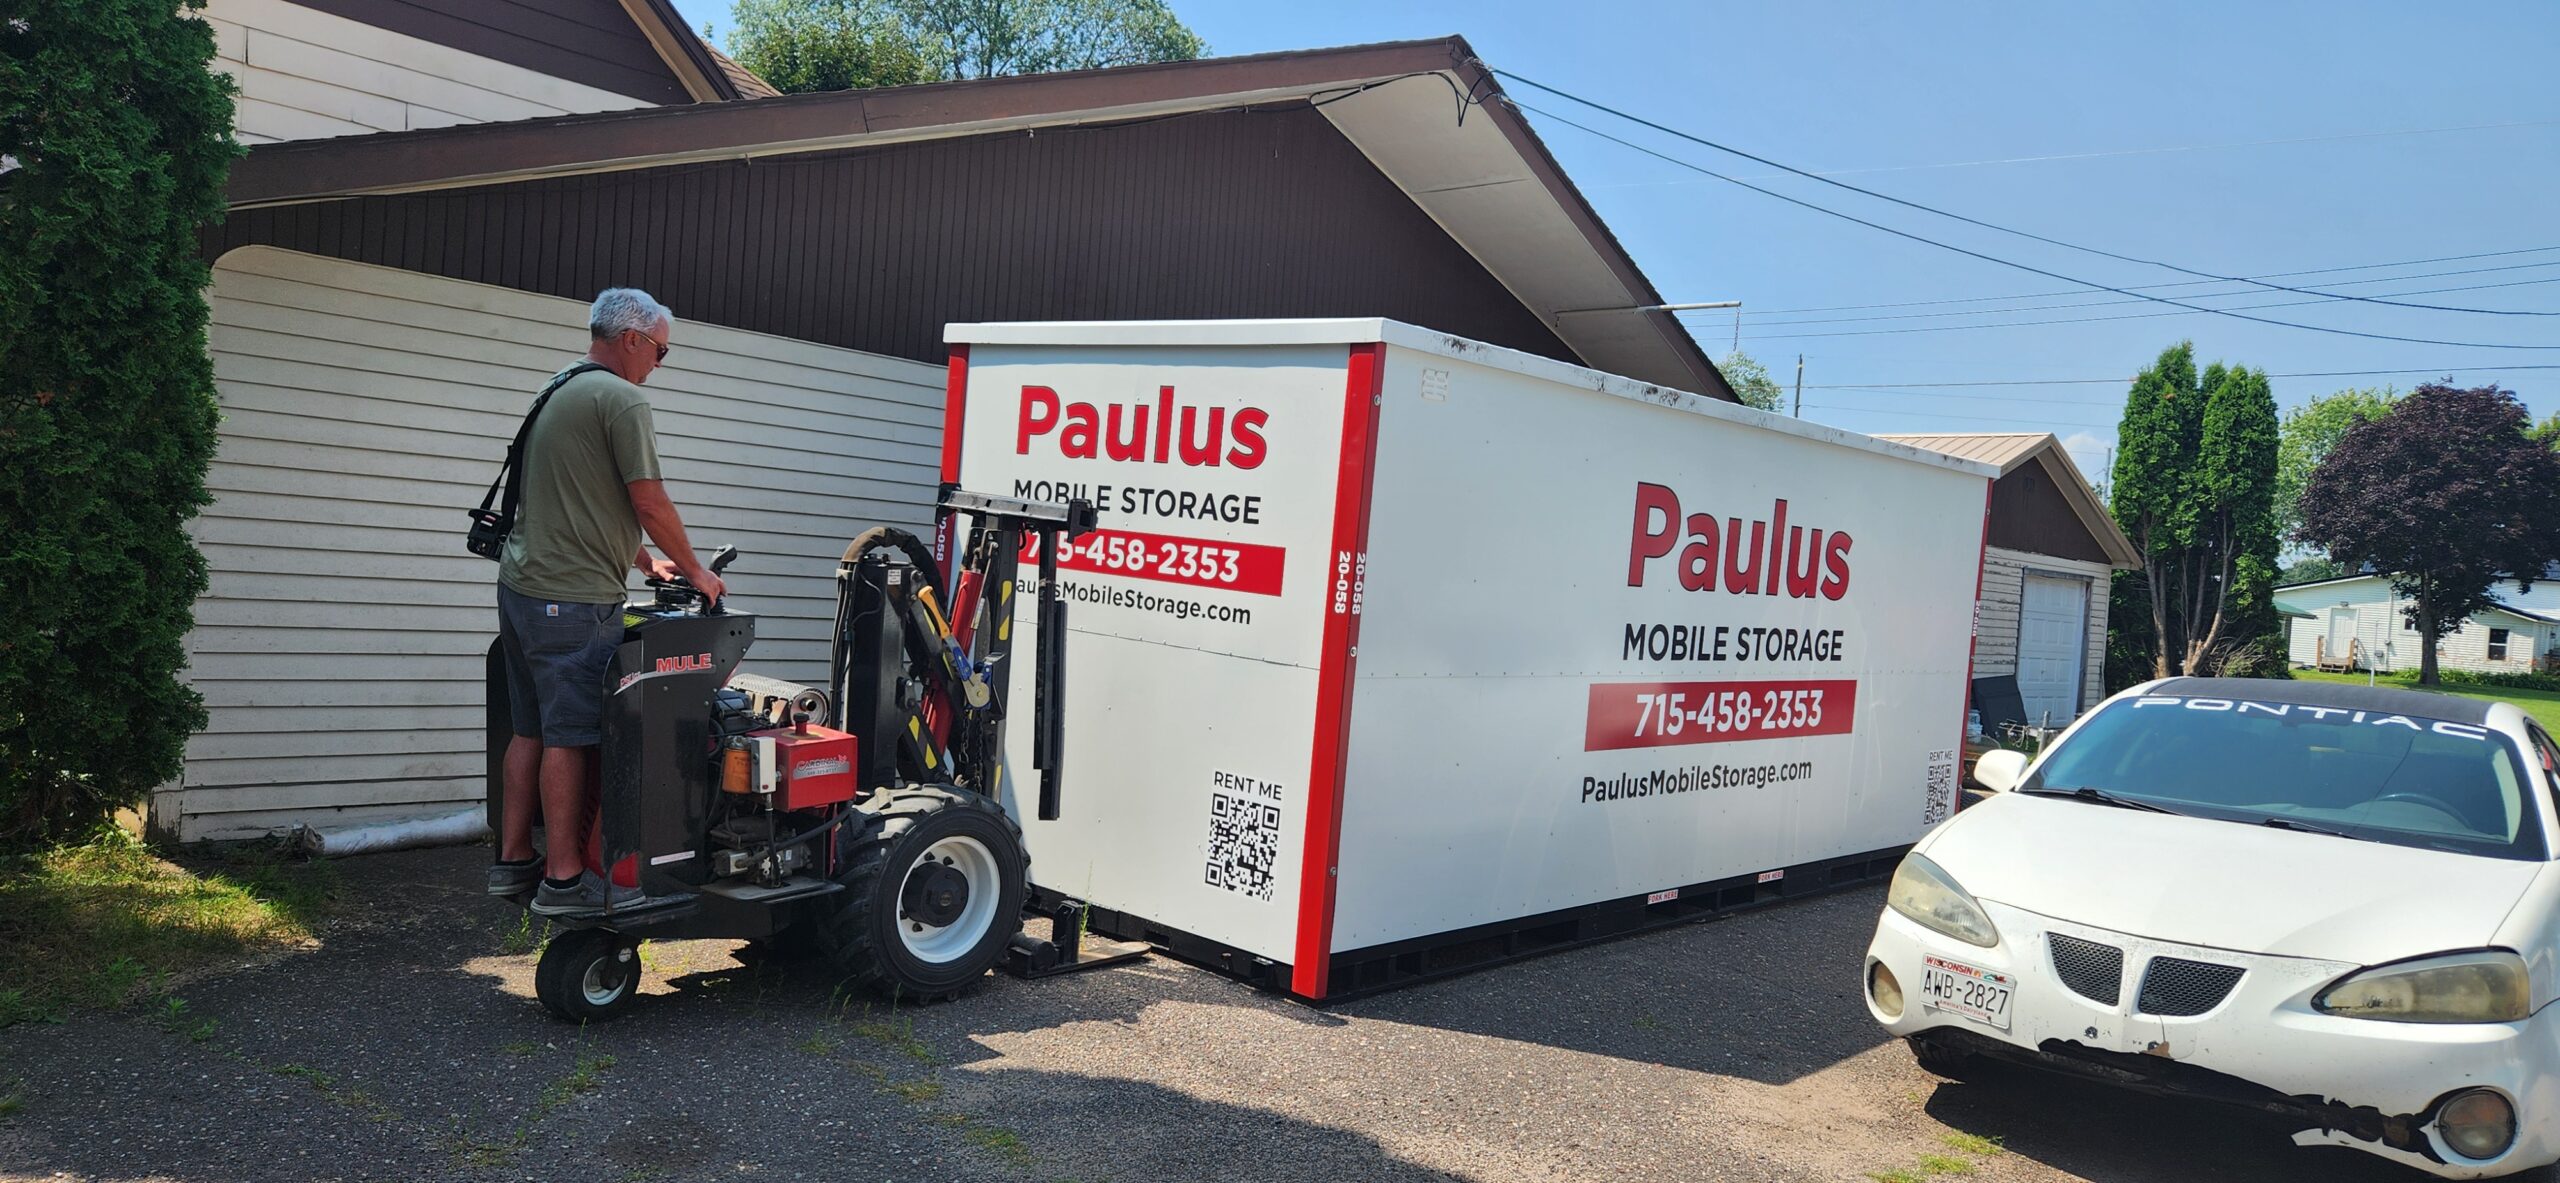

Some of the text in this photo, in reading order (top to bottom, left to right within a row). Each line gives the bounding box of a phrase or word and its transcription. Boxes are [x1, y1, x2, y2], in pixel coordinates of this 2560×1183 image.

[1016, 385, 1269, 470] Paulus
[1122, 487, 1261, 525] STORAGE
[936, 516, 947, 562] 0-058
[1028, 530, 1239, 582] 75-458-2353
[1627, 481, 1853, 601] Paulus
[1016, 579, 1251, 625] ausMobileStorage.com
[1334, 551, 1351, 614] 20-058
[1352, 552, 1366, 615] 20-058
[656, 653, 712, 673] MULE
[1623, 623, 1844, 661] MOBILE STORAGE
[1634, 690, 1824, 737] 715-458-2353
[2133, 697, 2489, 741] PONTIAC
[1929, 750, 1953, 761] RENT ME
[1214, 771, 1283, 801] RENT ME
[1581, 761, 1812, 803] PaulusMobileStorage.com
[1648, 890, 1677, 903] FORK HERE
[1926, 956, 1973, 975] WISCONSIN
[1923, 970, 2008, 1014] AWB-2827
